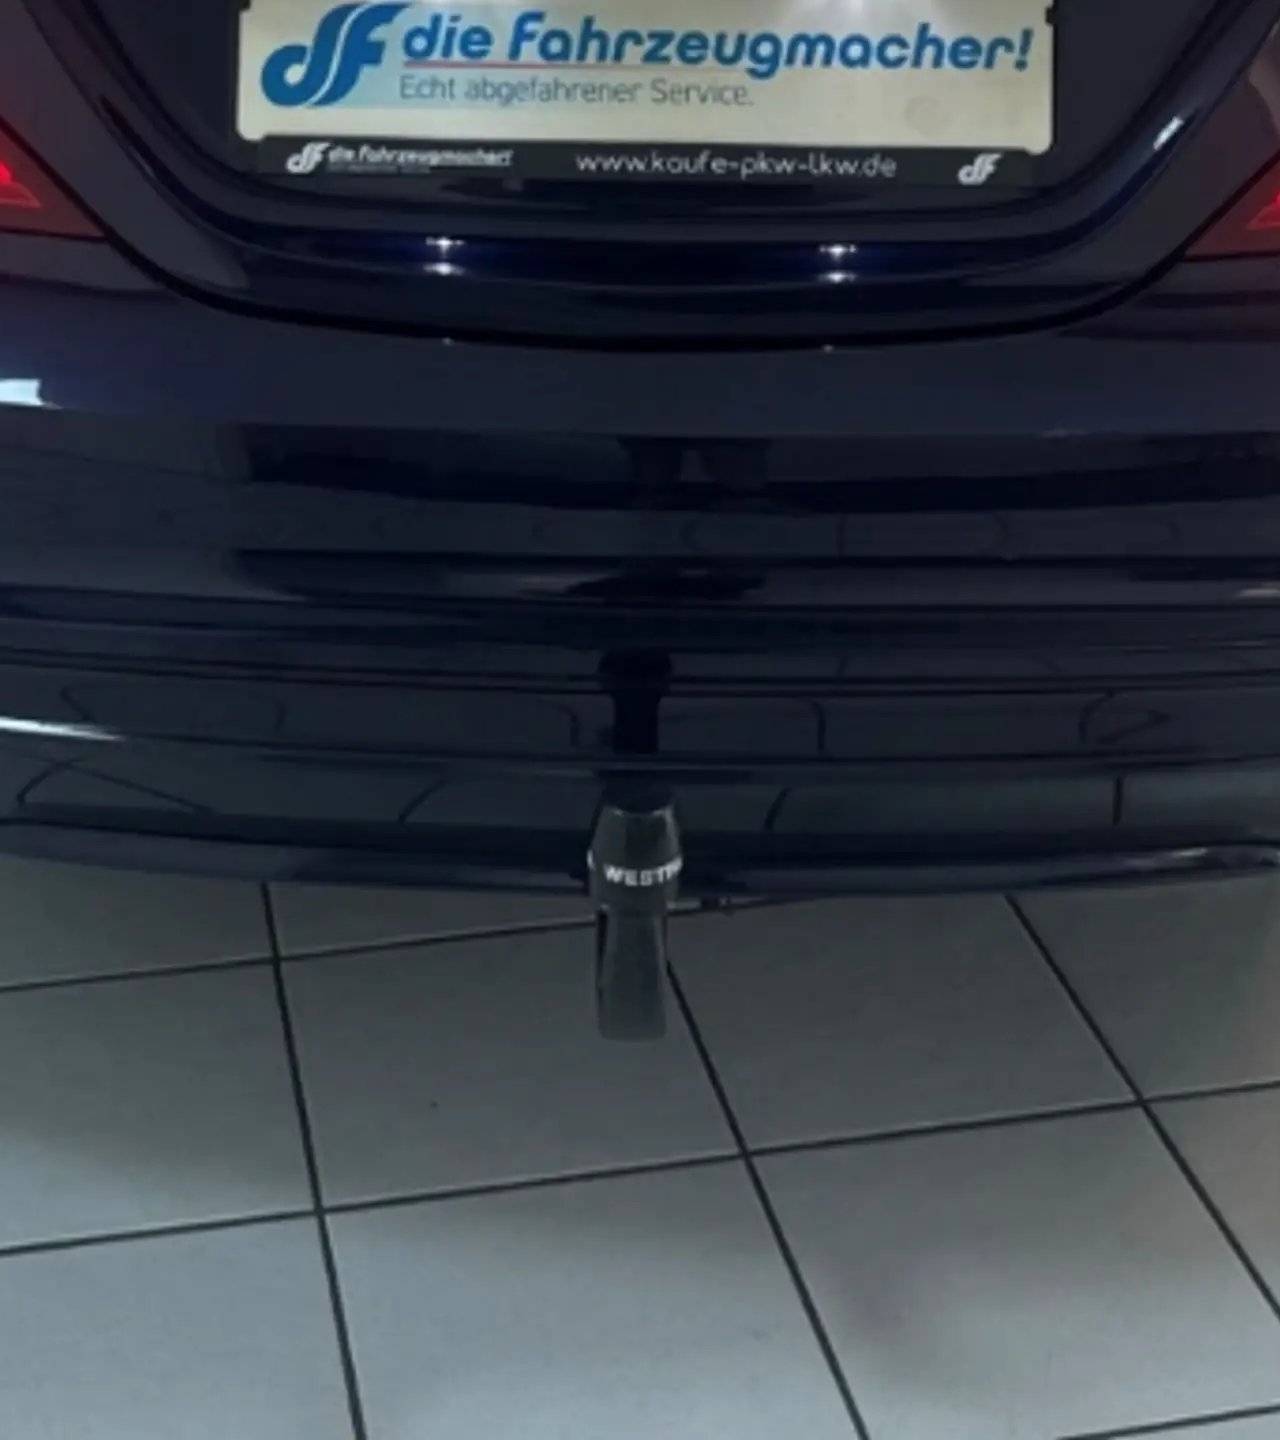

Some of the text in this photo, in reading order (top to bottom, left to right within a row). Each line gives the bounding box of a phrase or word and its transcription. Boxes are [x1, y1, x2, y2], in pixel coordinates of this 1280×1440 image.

[402, 11, 1034, 80] die Fahrzeugmacher!
[398, 75, 755, 108] Echt abgefahrener Service.
[575, 149, 898, 181] www.kaufe-pkw-lkw.de
